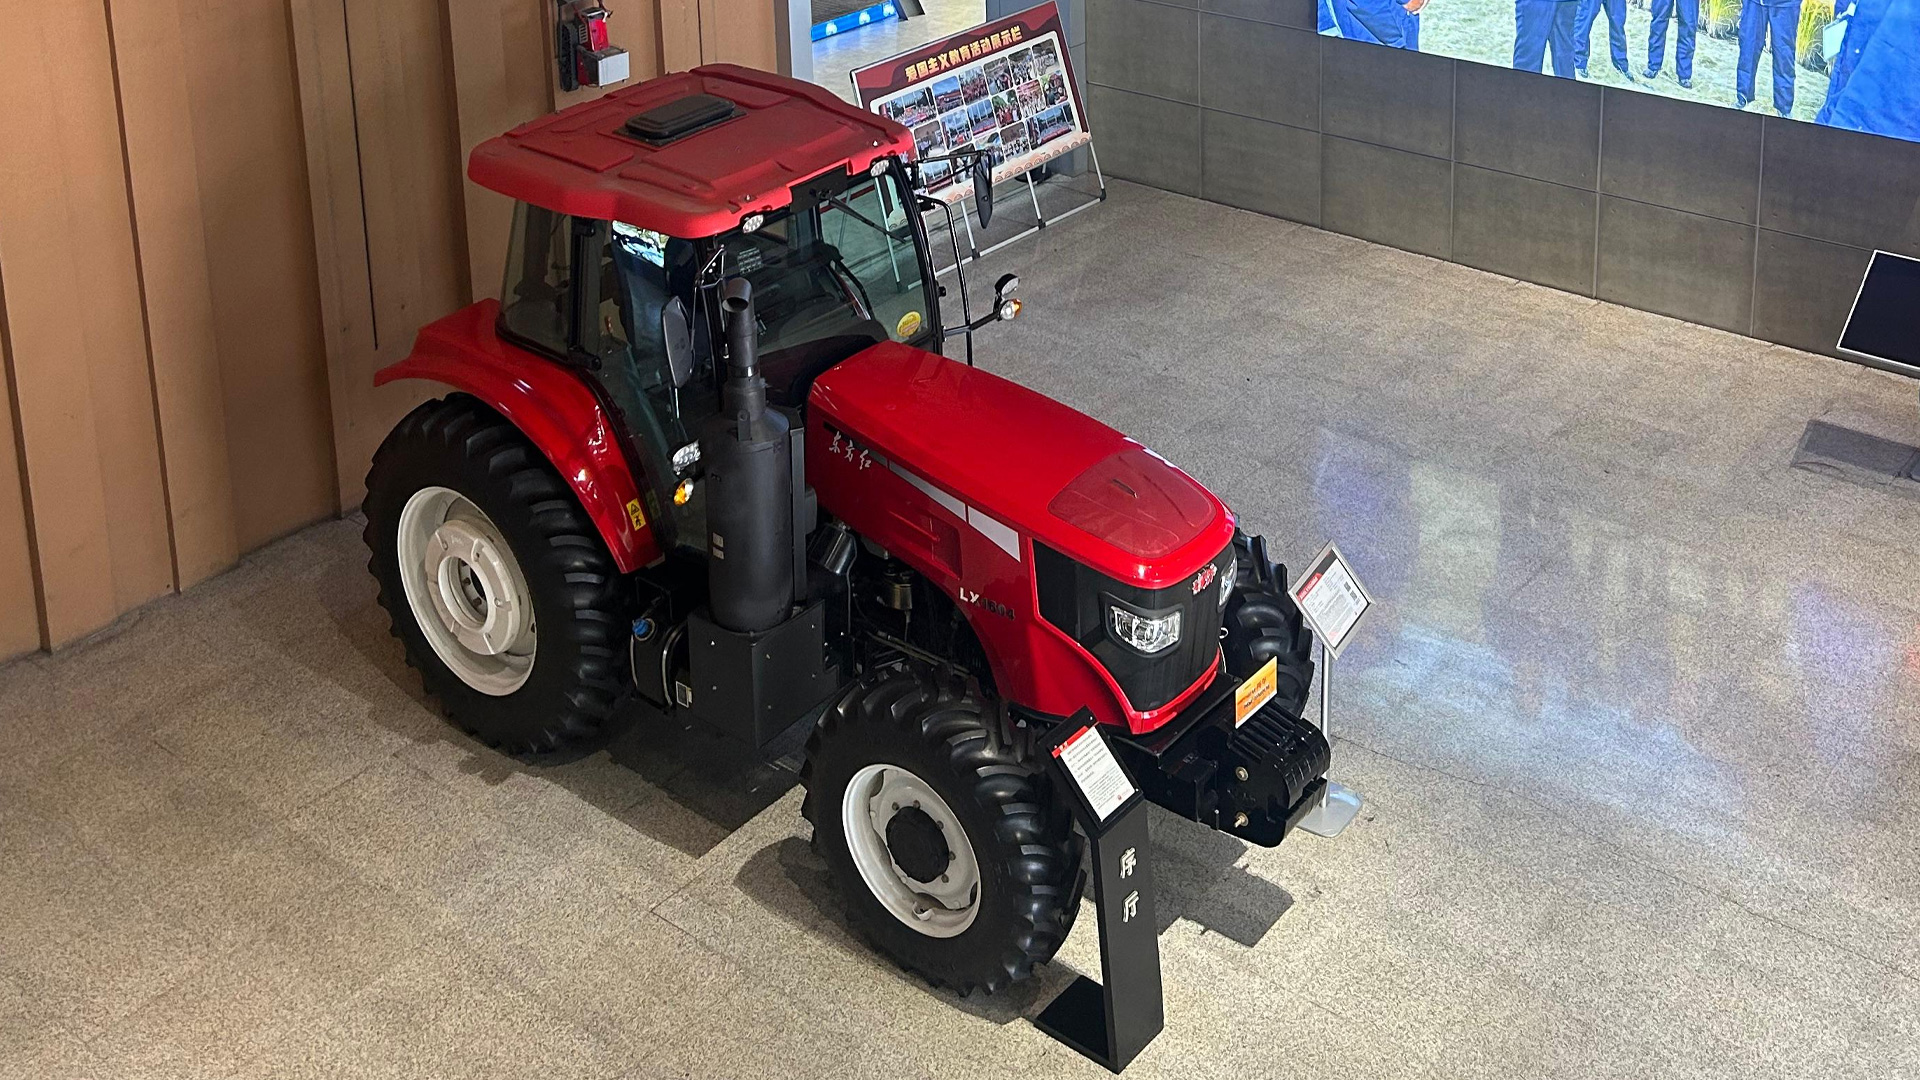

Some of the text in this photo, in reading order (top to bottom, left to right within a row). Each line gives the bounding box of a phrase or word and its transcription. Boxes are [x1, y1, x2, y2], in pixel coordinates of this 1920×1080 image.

[905, 25, 1022, 82] 爱国主义教育活动展示栏
[829, 430, 871, 470] 东方红
[1120, 847, 1139, 922] 序厅
